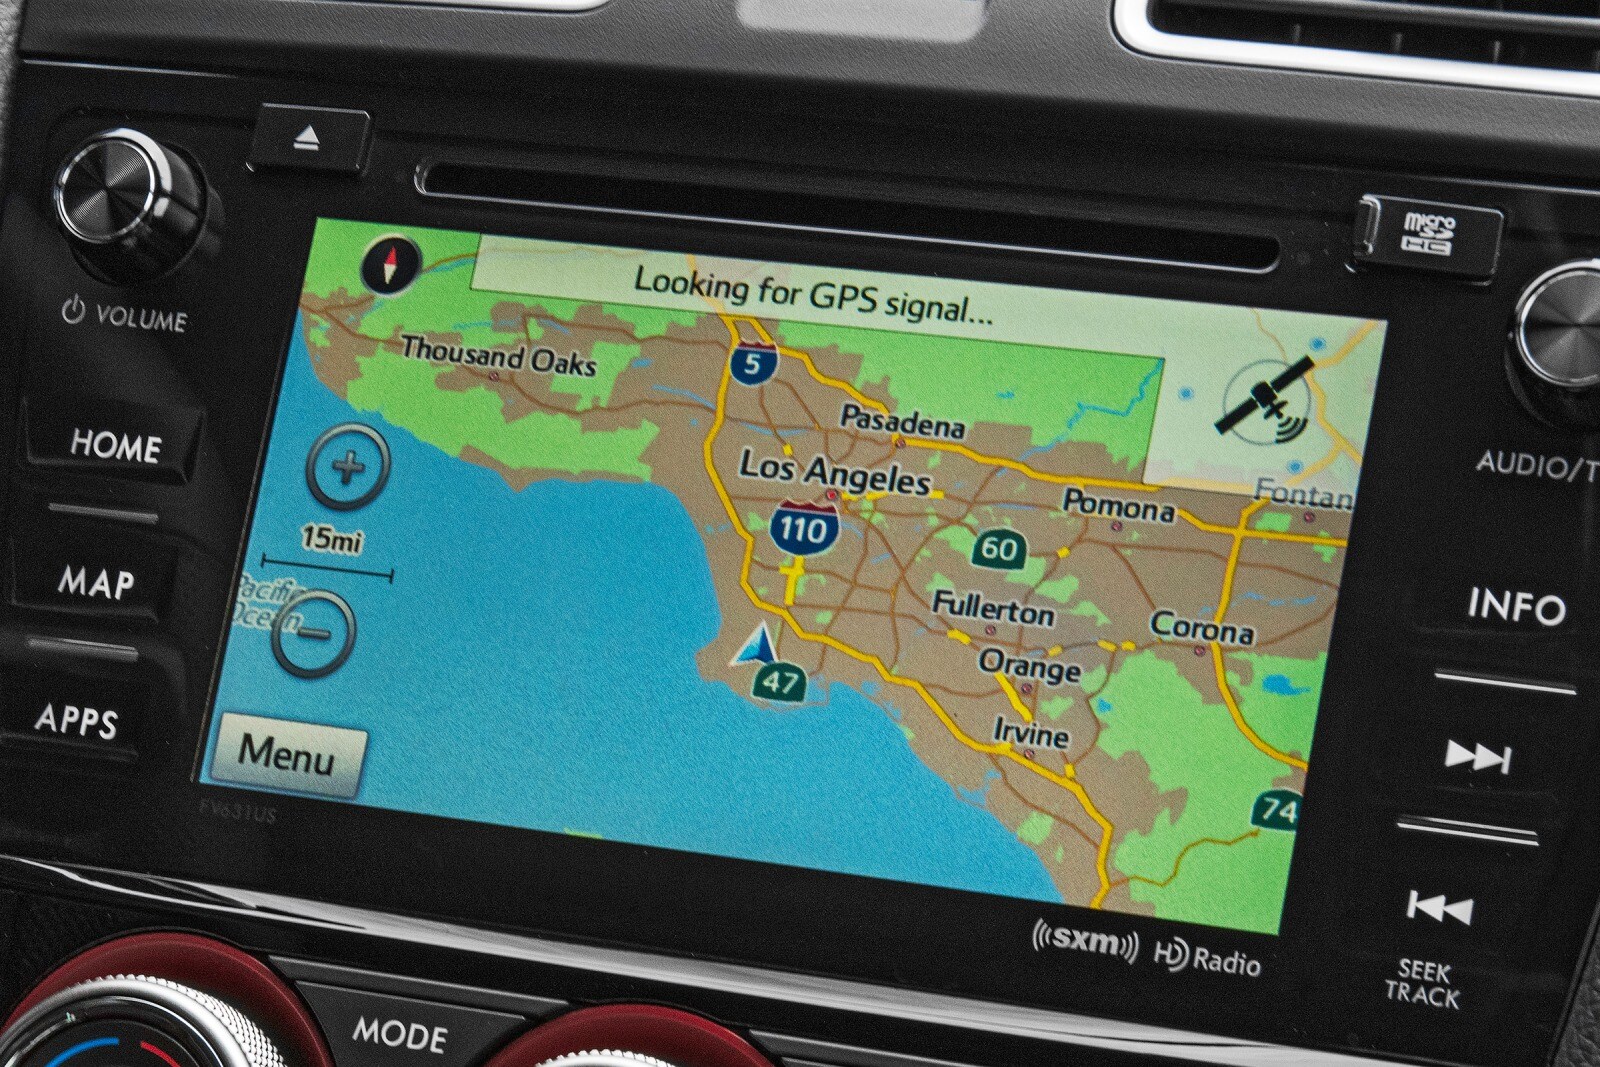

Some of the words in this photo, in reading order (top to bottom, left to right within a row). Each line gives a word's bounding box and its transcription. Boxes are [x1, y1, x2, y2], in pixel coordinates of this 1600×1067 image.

[634, 265, 750, 307] Looking
[758, 276, 803, 305] for
[809, 282, 879, 313] GPS
[884, 295, 993, 325] signal...
[97, 303, 188, 333] VOLUME
[401, 334, 525, 370] Thousand
[531, 347, 597, 377] Oaks
[744, 353, 761, 375] 5
[841, 403, 965, 440] Pasadena
[70, 427, 162, 464] HOME
[739, 449, 795, 480] Los
[803, 456, 931, 496] Angeles
[1475, 449, 1600, 483] AUDIO/T
[1062, 487, 1176, 524] Pomona
[303, 525, 363, 554] 15mi
[781, 515, 827, 544] 110
[981, 536, 1018, 562] 60
[57, 564, 135, 600] MAP
[932, 589, 1055, 627] Fullerton
[1468, 586, 1566, 626] INFO
[1150, 610, 1255, 646] Corona
[761, 670, 799, 695] 47
[979, 648, 1081, 686] Orange
[34, 702, 119, 740] APPS
[993, 716, 1069, 749] Irvine
[237, 732, 335, 776] Menu
[1262, 796, 1299, 824] 74
[1051, 926, 1120, 956] sxm
[1153, 935, 1190, 973] HD
[1193, 946, 1261, 977] Radio
[1398, 957, 1452, 985] SEEK
[1385, 978, 1461, 1010] TRACK
[352, 1014, 449, 1055] MODE
